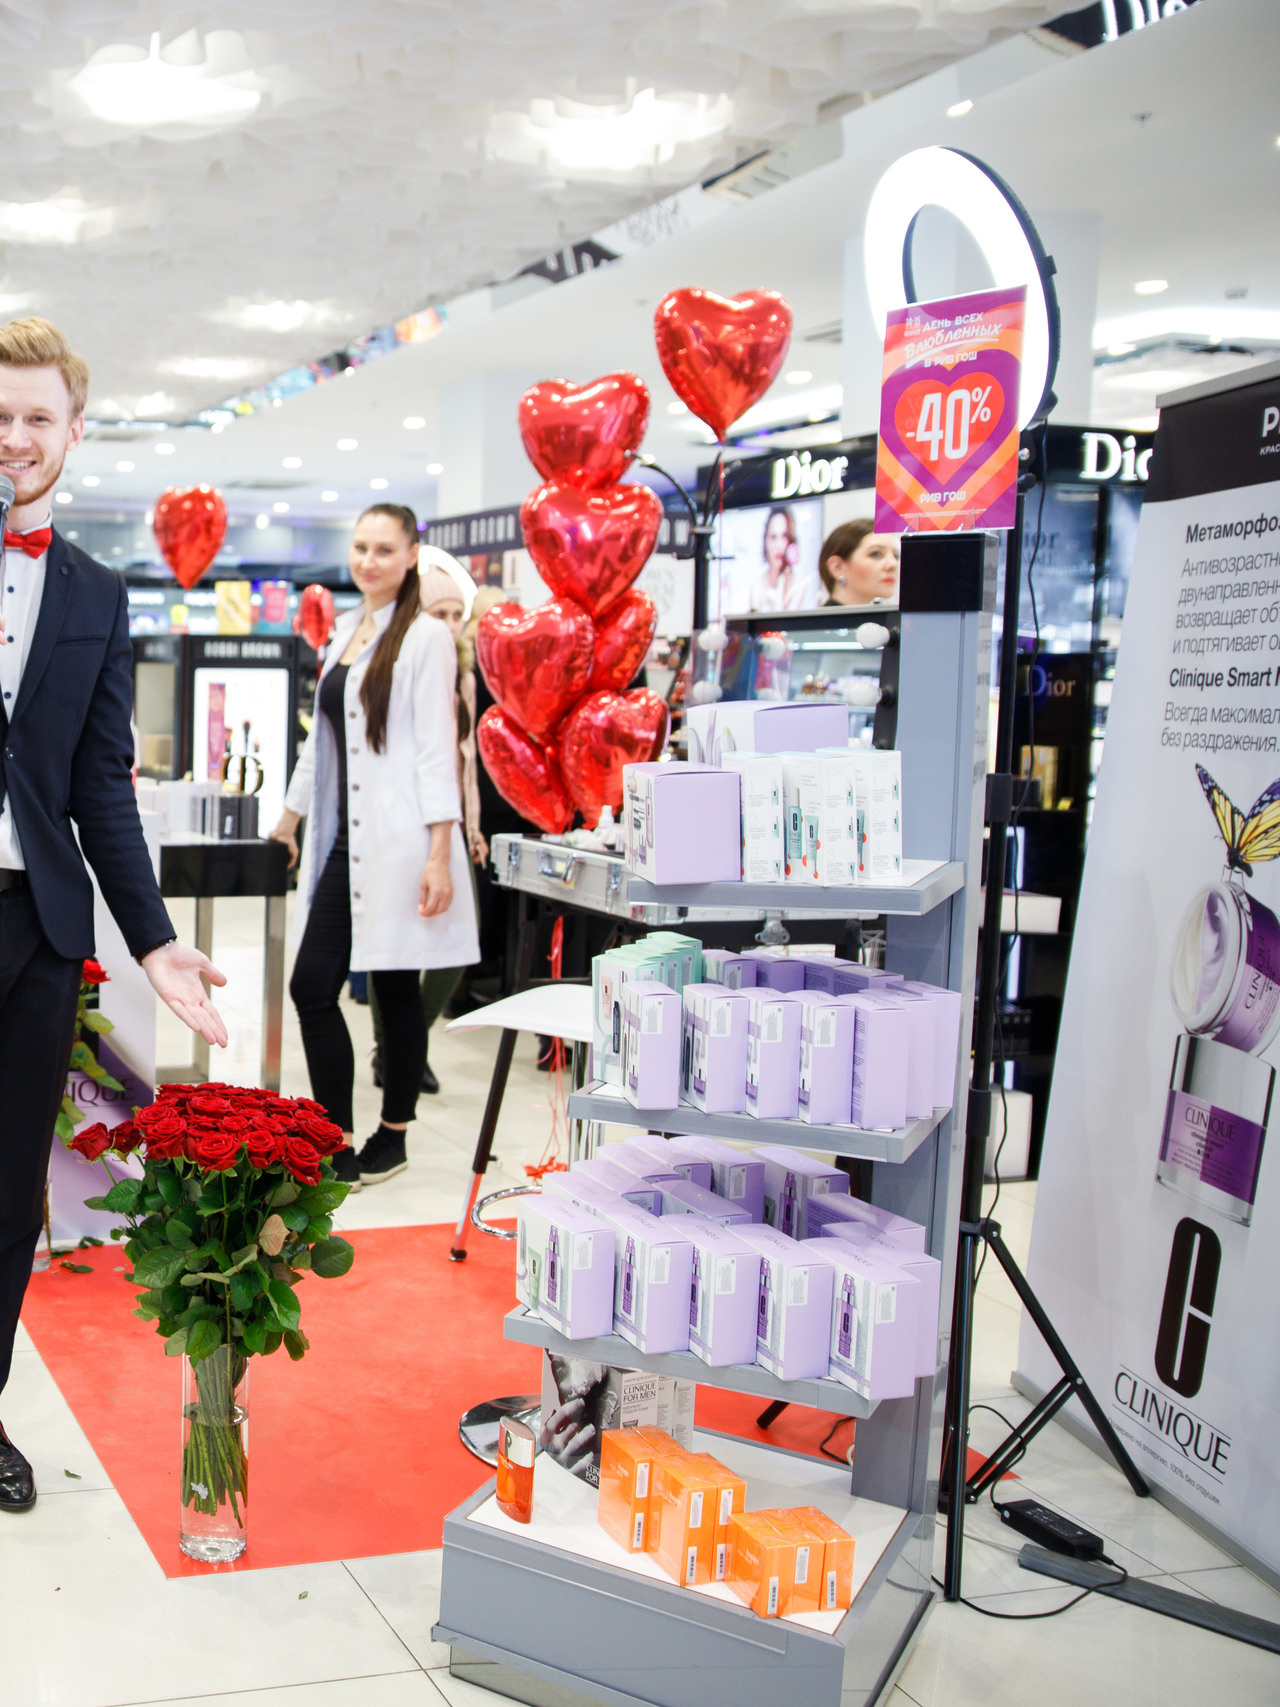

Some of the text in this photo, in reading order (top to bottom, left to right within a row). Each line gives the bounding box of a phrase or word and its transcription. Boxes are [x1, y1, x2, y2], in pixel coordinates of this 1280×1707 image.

[923, 318, 951, 333] ДЕНЬ
[955, 312, 984, 326] ВСЕХ
[934, 354, 955, 366] РИВ
[956, 350, 978, 362] ГОШ
[905, 385, 993, 462] -40%
[771, 450, 848, 498] Dior
[920, 490, 967, 504] РИВ ГОШ
[1186, 513, 1280, 544] Метаморфо
[1181, 551, 1280, 577] Антивозрастн
[1176, 601, 1280, 631] возвращает об
[1172, 639, 1181, 654] и
[1183, 635, 1267, 657] подтягивает
[1023, 664, 1077, 698] Dior
[1169, 667, 1224, 692] Clinique
[1227, 667, 1273, 687] Smart
[1164, 701, 1208, 726] Всегда
[1161, 726, 1280, 754] без раздражения.
[1185, 1106, 1237, 1141] CLINIQUE
[623, 1382, 656, 1395] CLINIQUE
[623, 1390, 656, 1402] FOR MEN
[1114, 1371, 1231, 1476] CLINIQUE
